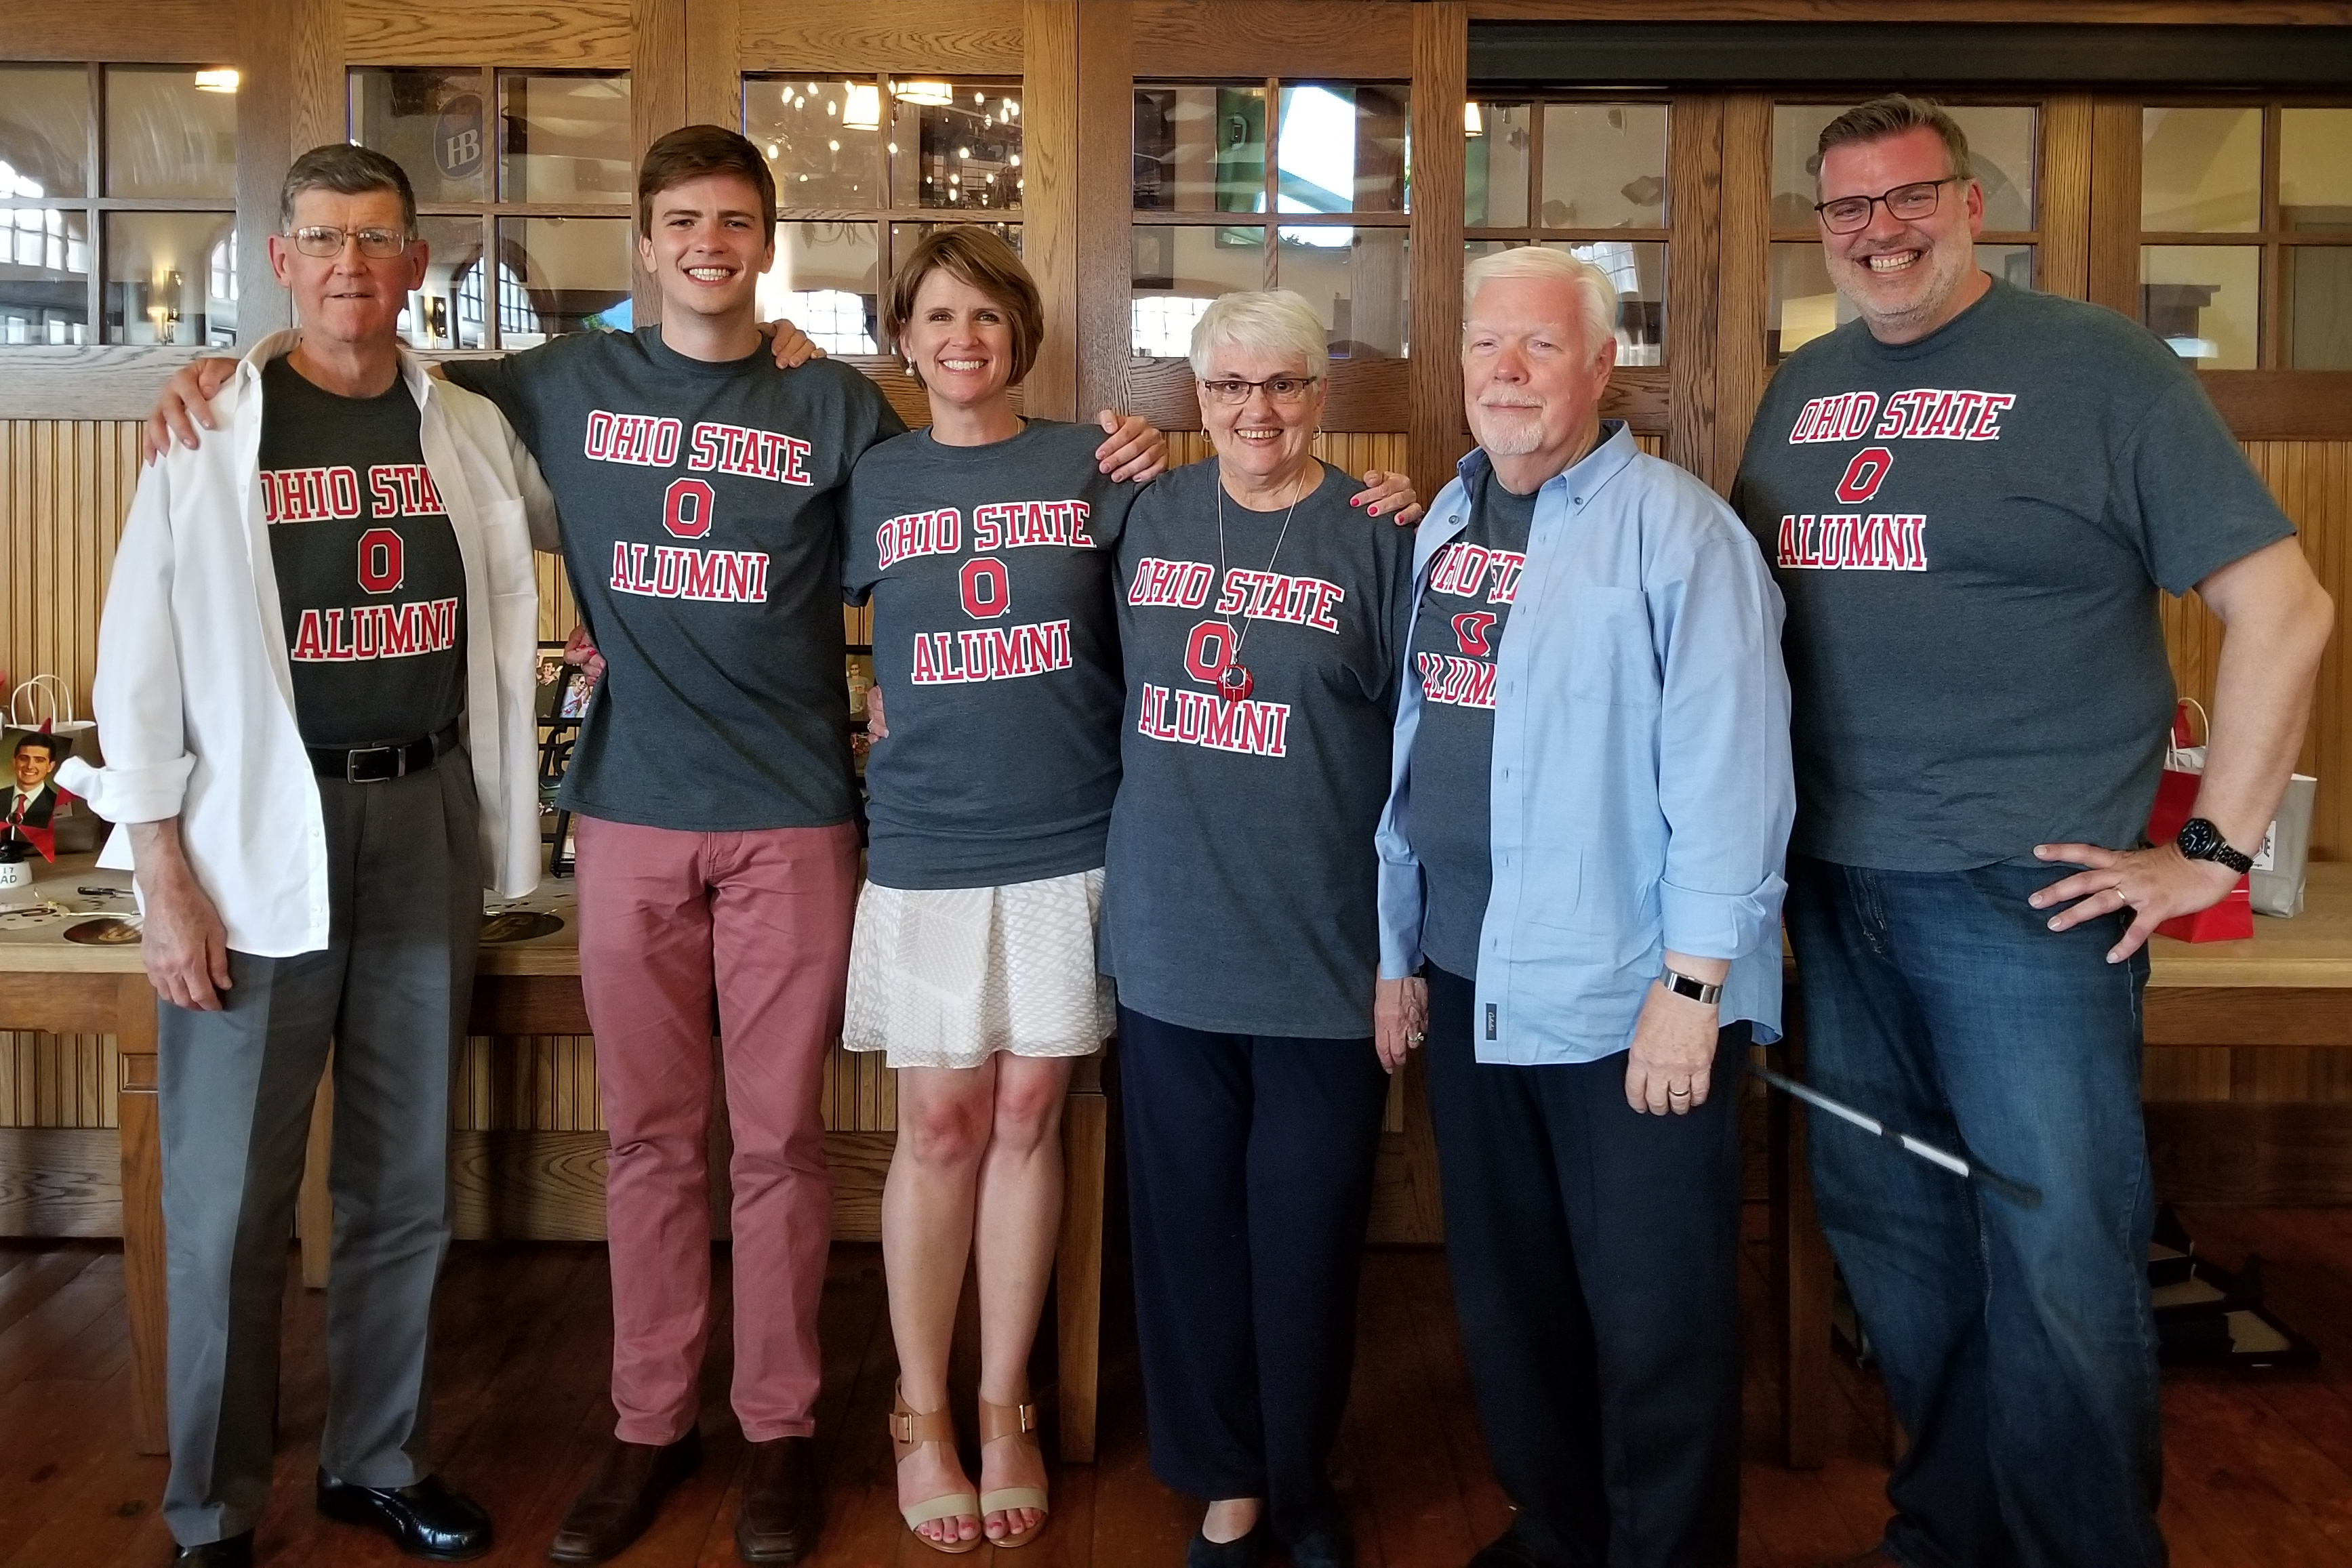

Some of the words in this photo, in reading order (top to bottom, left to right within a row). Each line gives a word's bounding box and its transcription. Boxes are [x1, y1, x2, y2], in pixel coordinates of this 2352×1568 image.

[446, 129, 480, 169] HB
[584, 409, 683, 468] OHIO
[687, 421, 812, 487] STATE
[1789, 392, 1879, 444] OHIO
[1874, 389, 2016, 440] STATE
[1835, 447, 1893, 503] O
[663, 477, 715, 539] O
[876, 508, 961, 571] OHIO
[973, 499, 1095, 552] STATE
[358, 528, 403, 594] O
[610, 541, 770, 603] ALUMNI
[1777, 514, 1926, 571] ALUMNI
[958, 557, 1011, 619] O
[1128, 558, 1215, 609] OHIO
[1215, 568, 1345, 634] STATE
[291, 597, 458, 662] ALUMNI
[911, 619, 1072, 684] ALUMNI
[1184, 620, 1238, 684] O
[1138, 682, 1291, 758] ALUMNI
